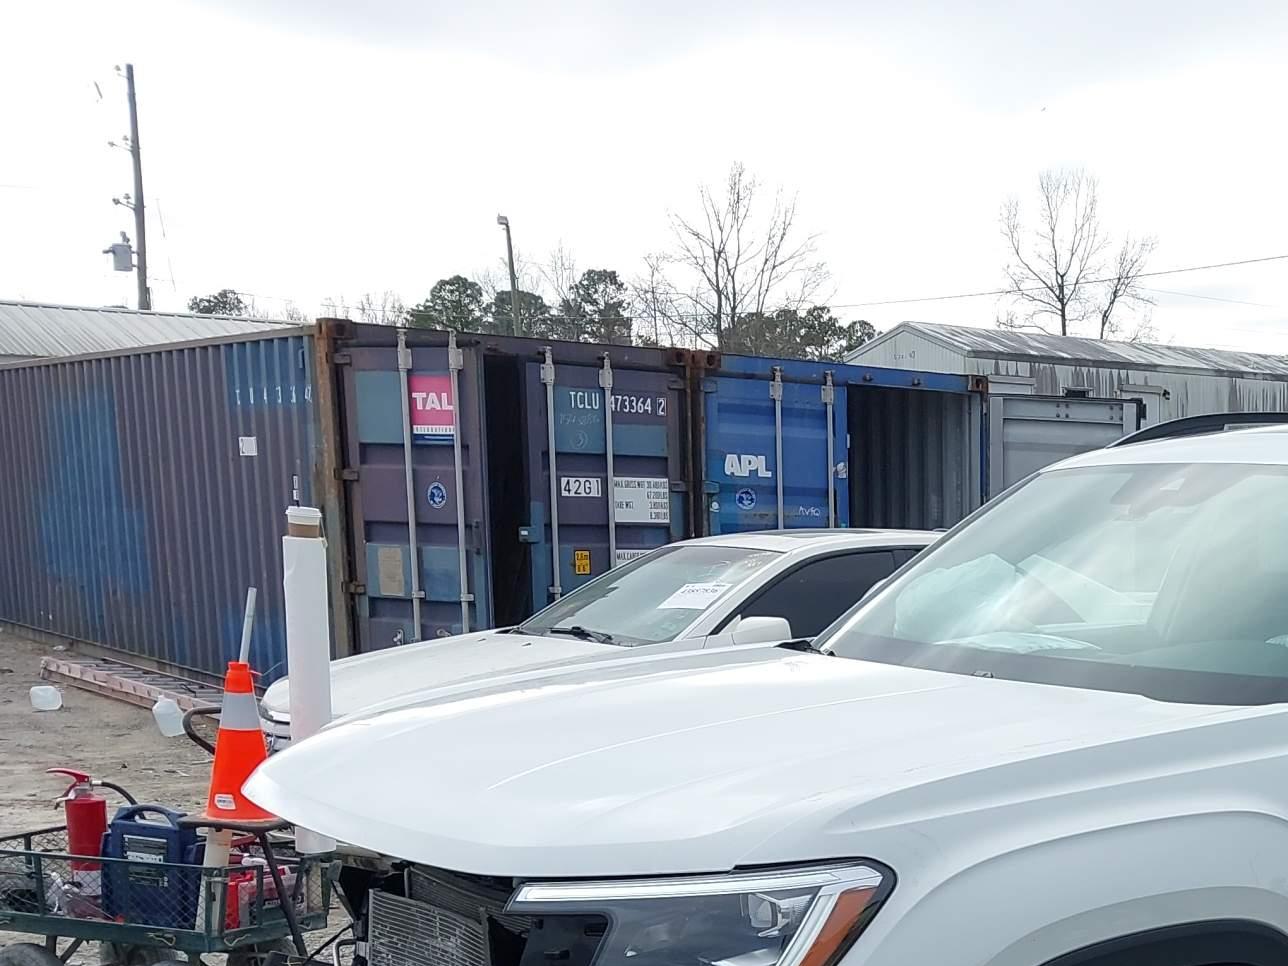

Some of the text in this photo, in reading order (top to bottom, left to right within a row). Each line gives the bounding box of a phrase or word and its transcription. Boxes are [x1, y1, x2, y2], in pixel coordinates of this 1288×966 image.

[412, 392, 454, 410] TAL
[569, 391, 666, 416] TCLU 473364 2
[724, 453, 772, 478] APL
[563, 478, 600, 496] 42G1
